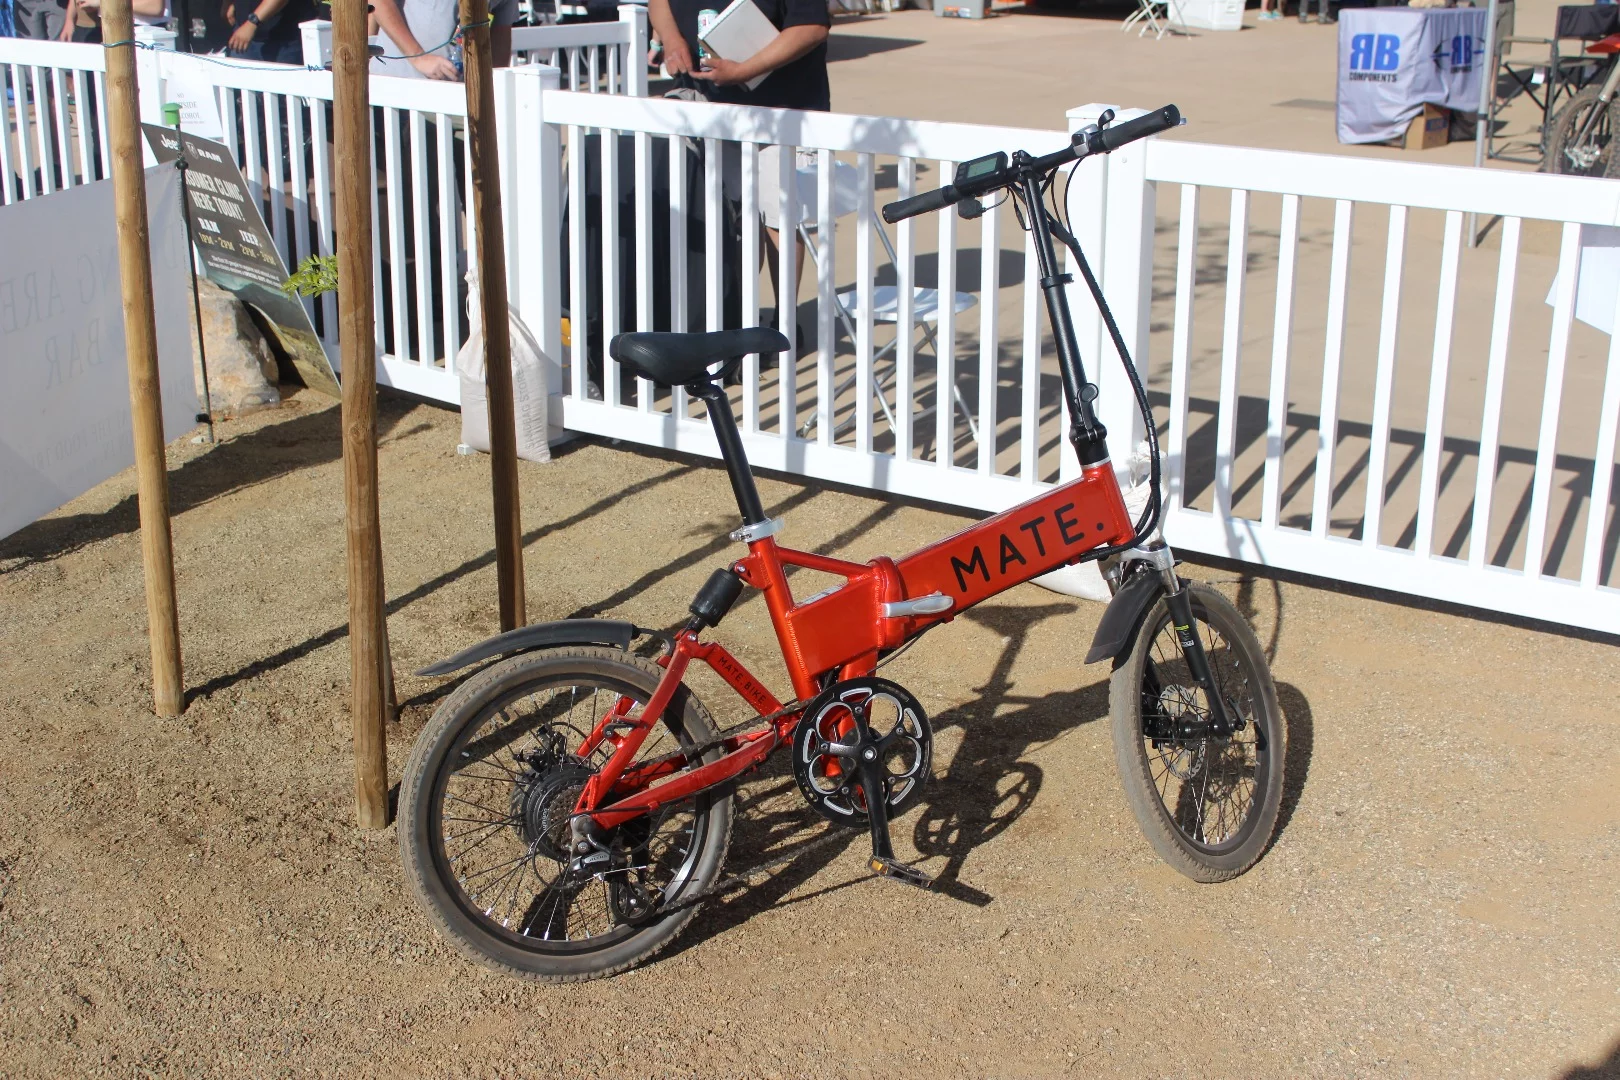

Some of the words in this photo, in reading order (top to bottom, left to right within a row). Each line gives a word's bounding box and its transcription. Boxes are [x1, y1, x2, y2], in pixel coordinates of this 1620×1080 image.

[1349, 72, 1397, 82] COMPONENTS
[160, 133, 179, 151] Jee
[197, 148, 222, 163] RAM
[213, 176, 244, 202] CLINIC
[189, 189, 217, 213] HERE
[212, 195, 246, 222] TODAY!
[197, 217, 220, 233] RAM
[516, 367, 530, 403] STORE
[950, 502, 1104, 593] MATE.
